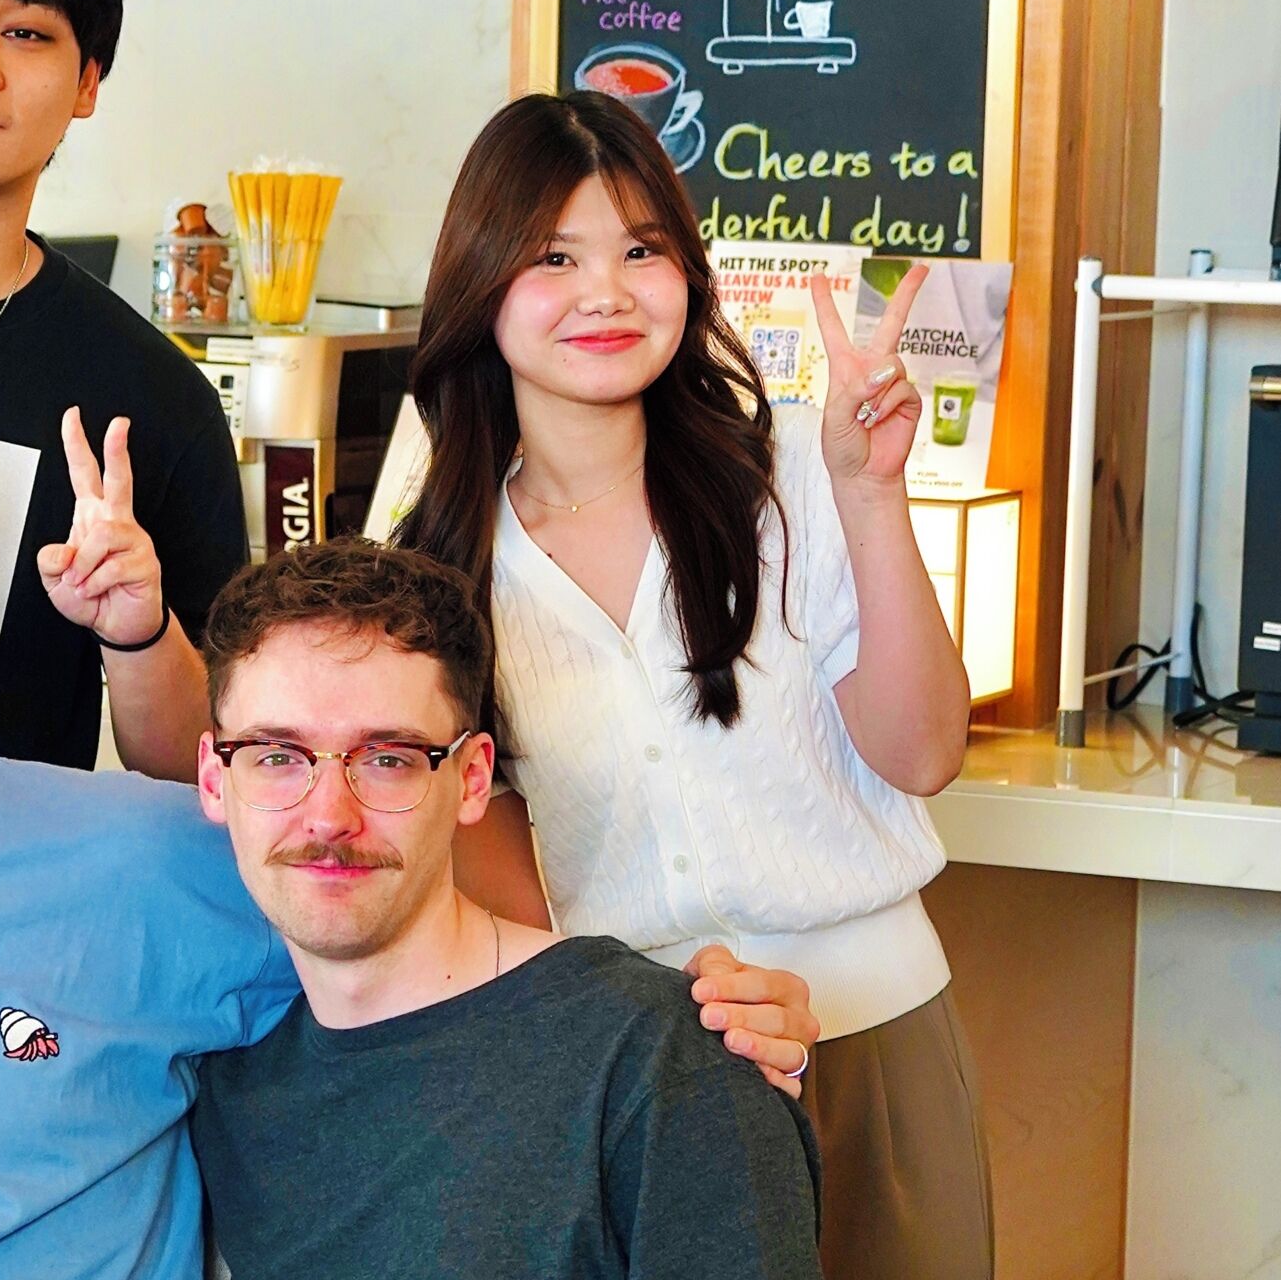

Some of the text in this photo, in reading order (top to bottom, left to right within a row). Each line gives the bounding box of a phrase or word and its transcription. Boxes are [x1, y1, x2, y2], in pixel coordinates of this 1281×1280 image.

[599, 3, 683, 32] coffee
[713, 123, 978, 180] Cheers to a
[698, 192, 973, 253] derful day!
[719, 257, 745, 270] HIT
[748, 258, 776, 272] THE
[763, 274, 782, 288] US
[786, 275, 796, 289] A
[800, 276, 852, 292] SET
[896, 341, 979, 358] PERIENCE
